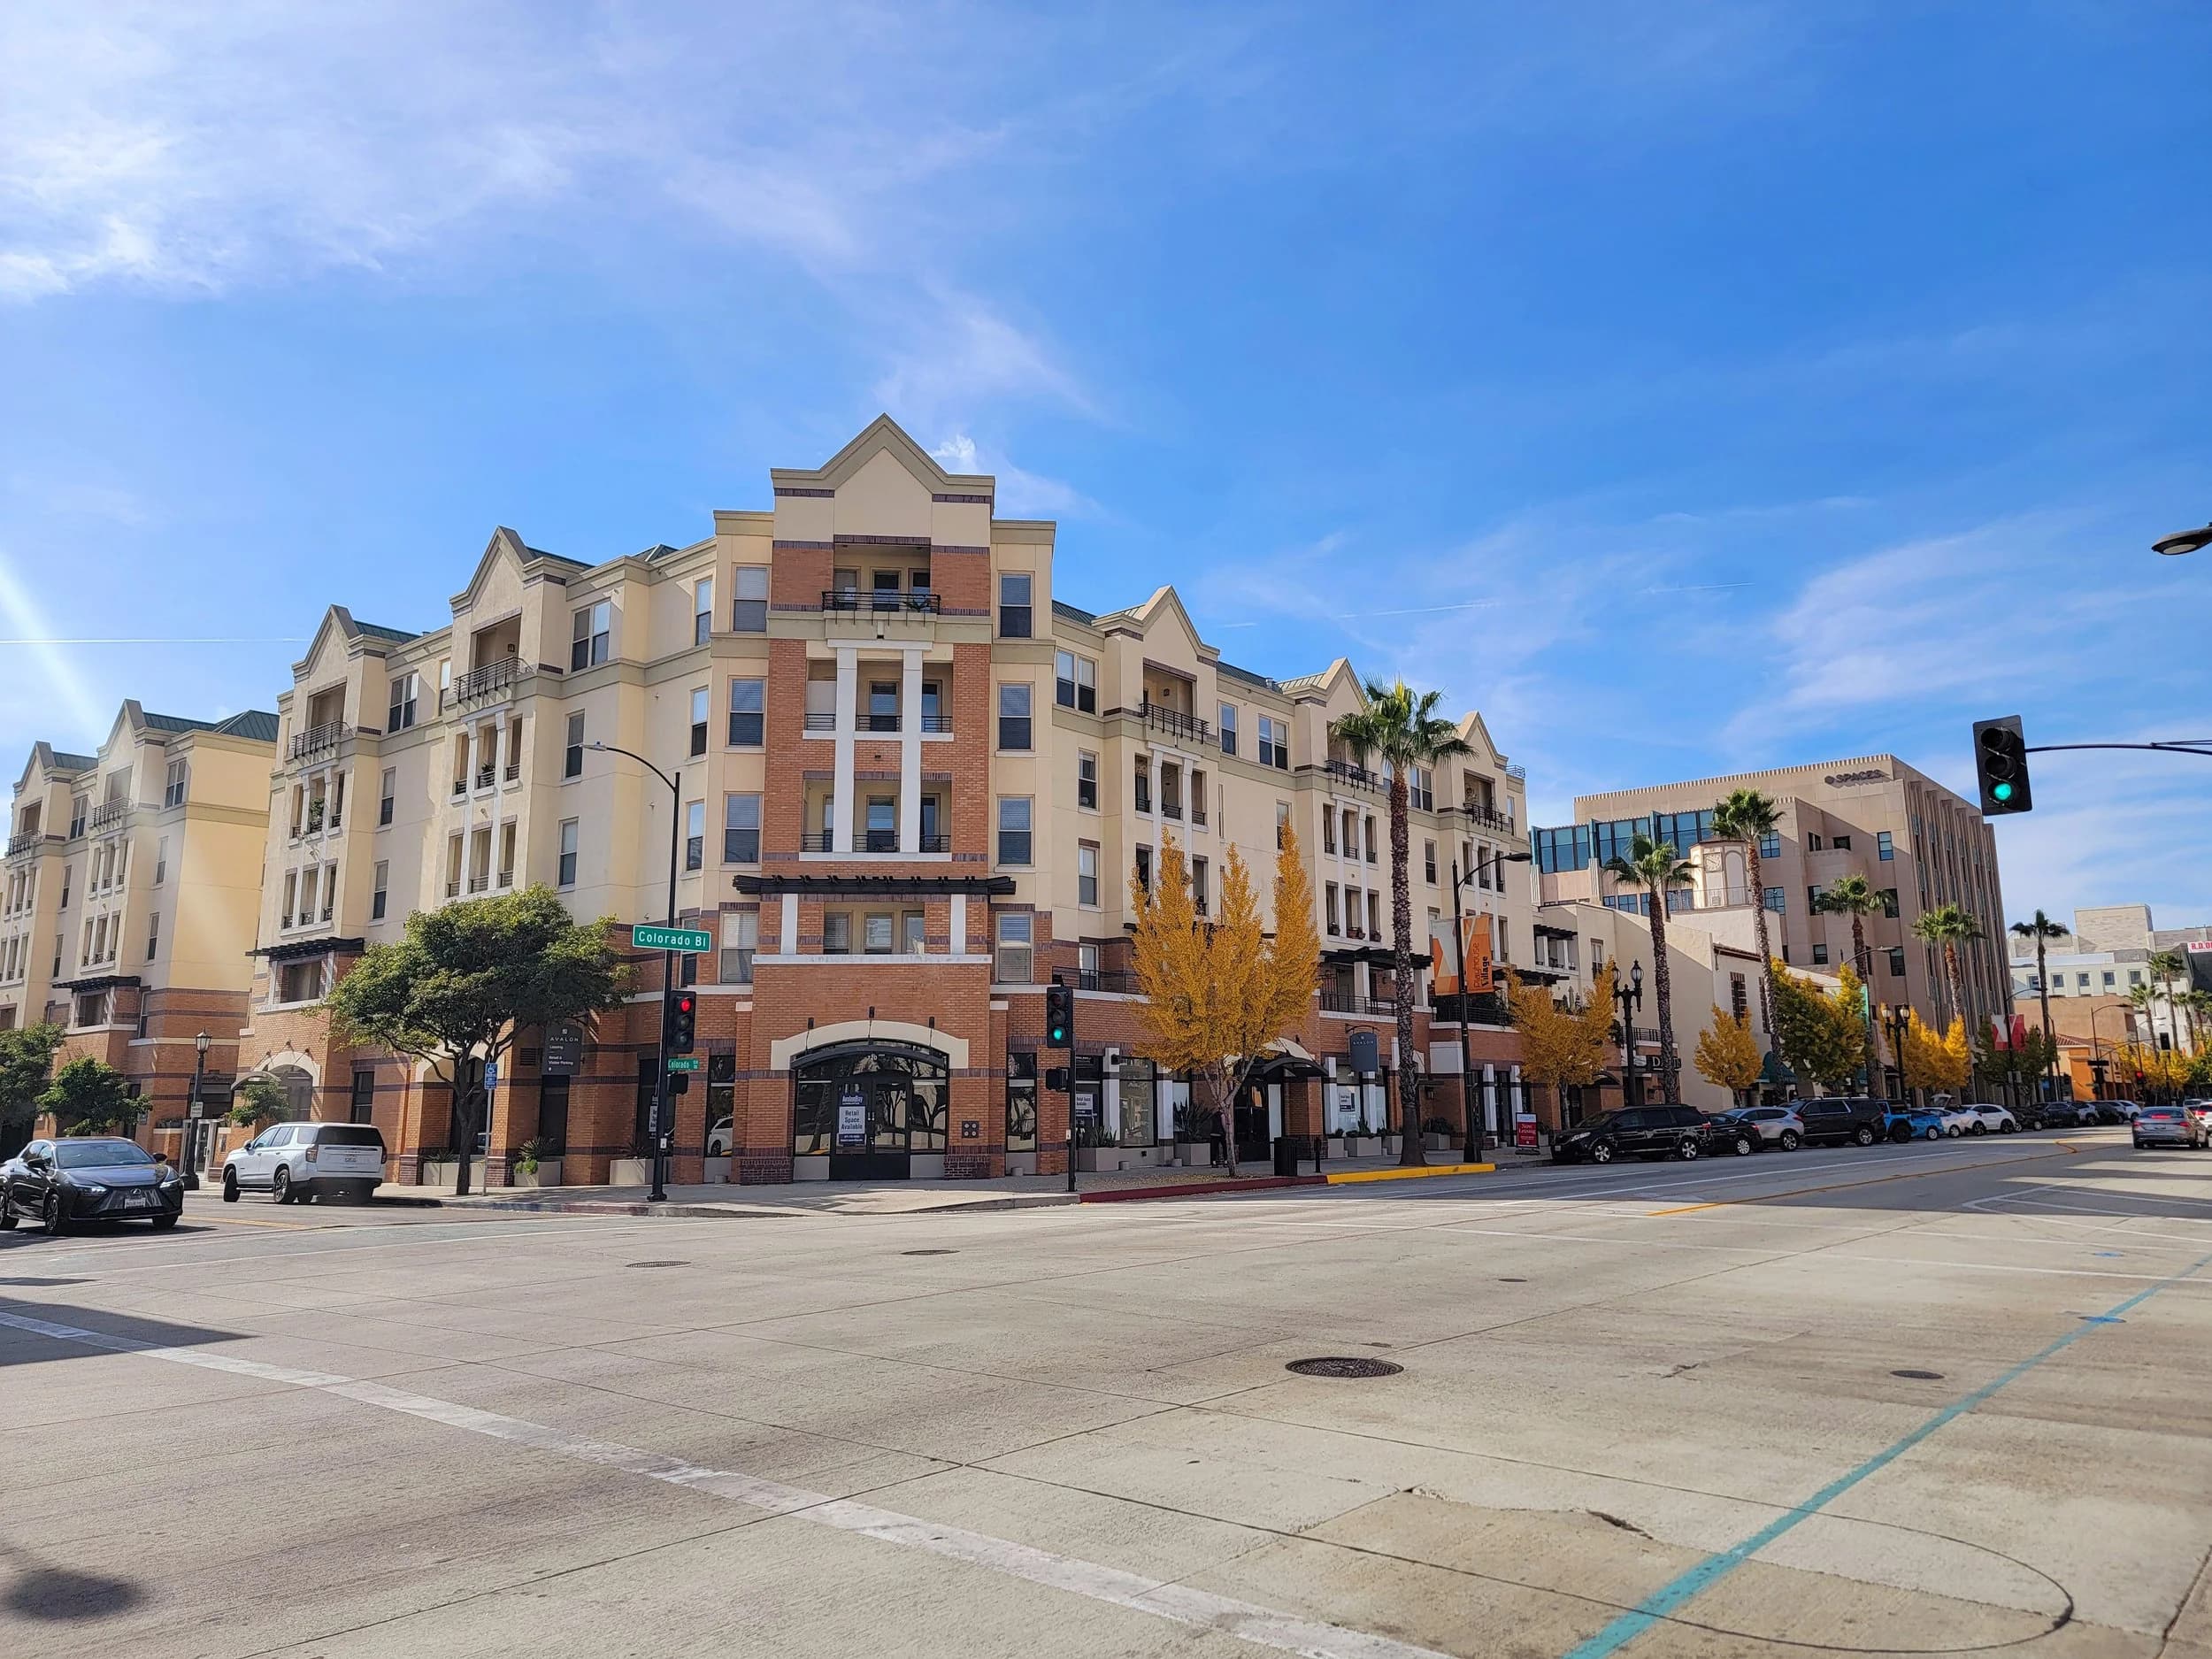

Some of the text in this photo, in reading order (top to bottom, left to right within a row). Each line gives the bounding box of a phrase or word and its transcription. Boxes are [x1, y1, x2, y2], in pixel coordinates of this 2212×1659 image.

[638, 931, 706, 947] Colorado Bl
[1480, 956, 1490, 987] Village
